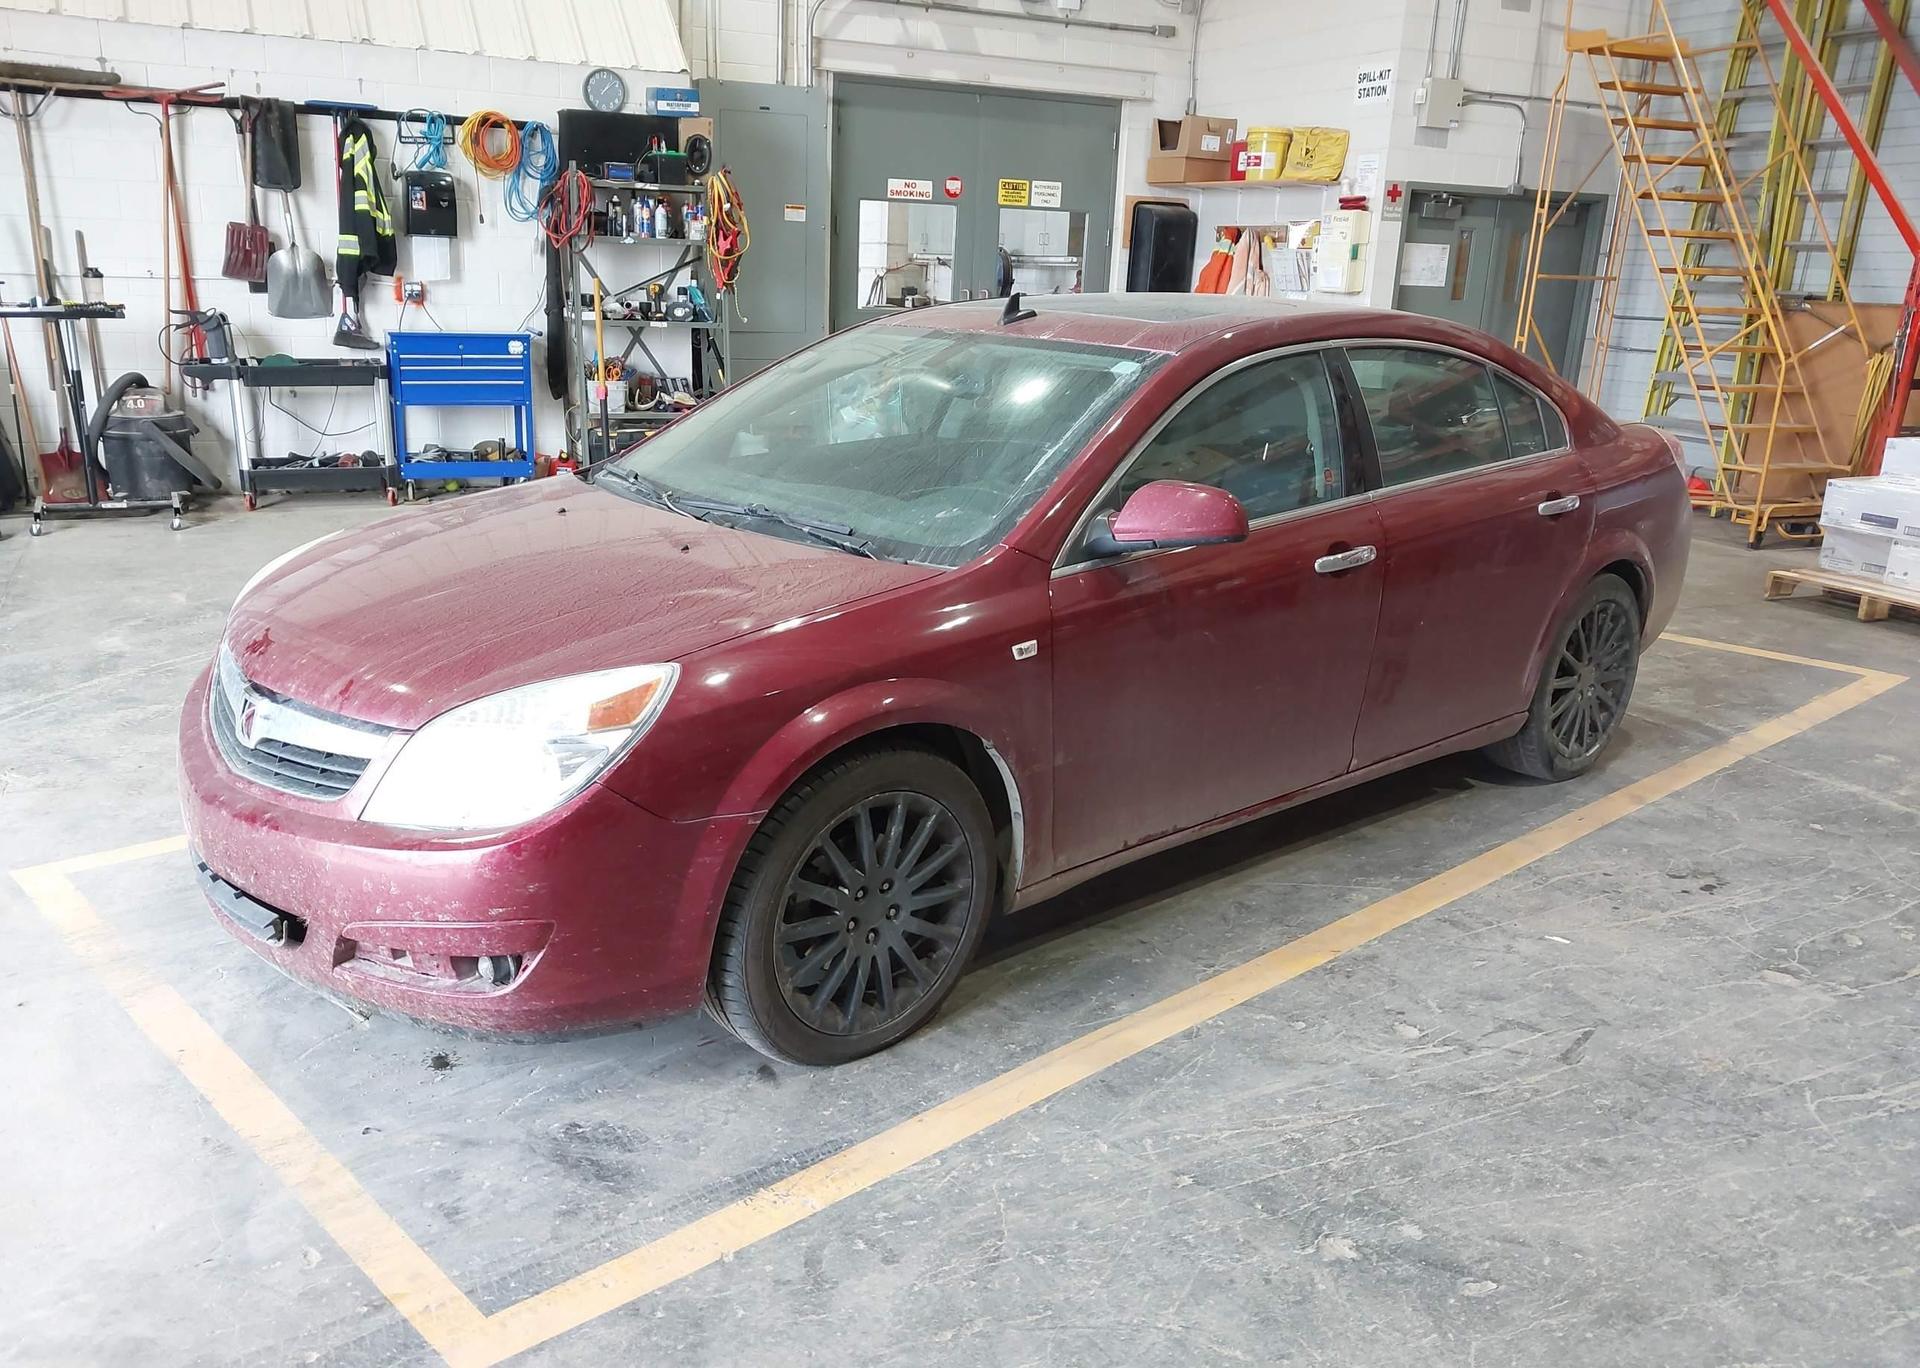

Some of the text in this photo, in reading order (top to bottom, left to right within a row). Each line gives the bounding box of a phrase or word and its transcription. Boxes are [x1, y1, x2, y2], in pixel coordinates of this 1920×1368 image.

[1358, 69, 1391, 84] SPILL-KIT
[1358, 85, 1387, 99] STATION
[904, 181, 917, 189] NO
[1002, 182, 1026, 190] CAUTION
[889, 189, 931, 198] SMOKING
[127, 399, 145, 409] 4.0
